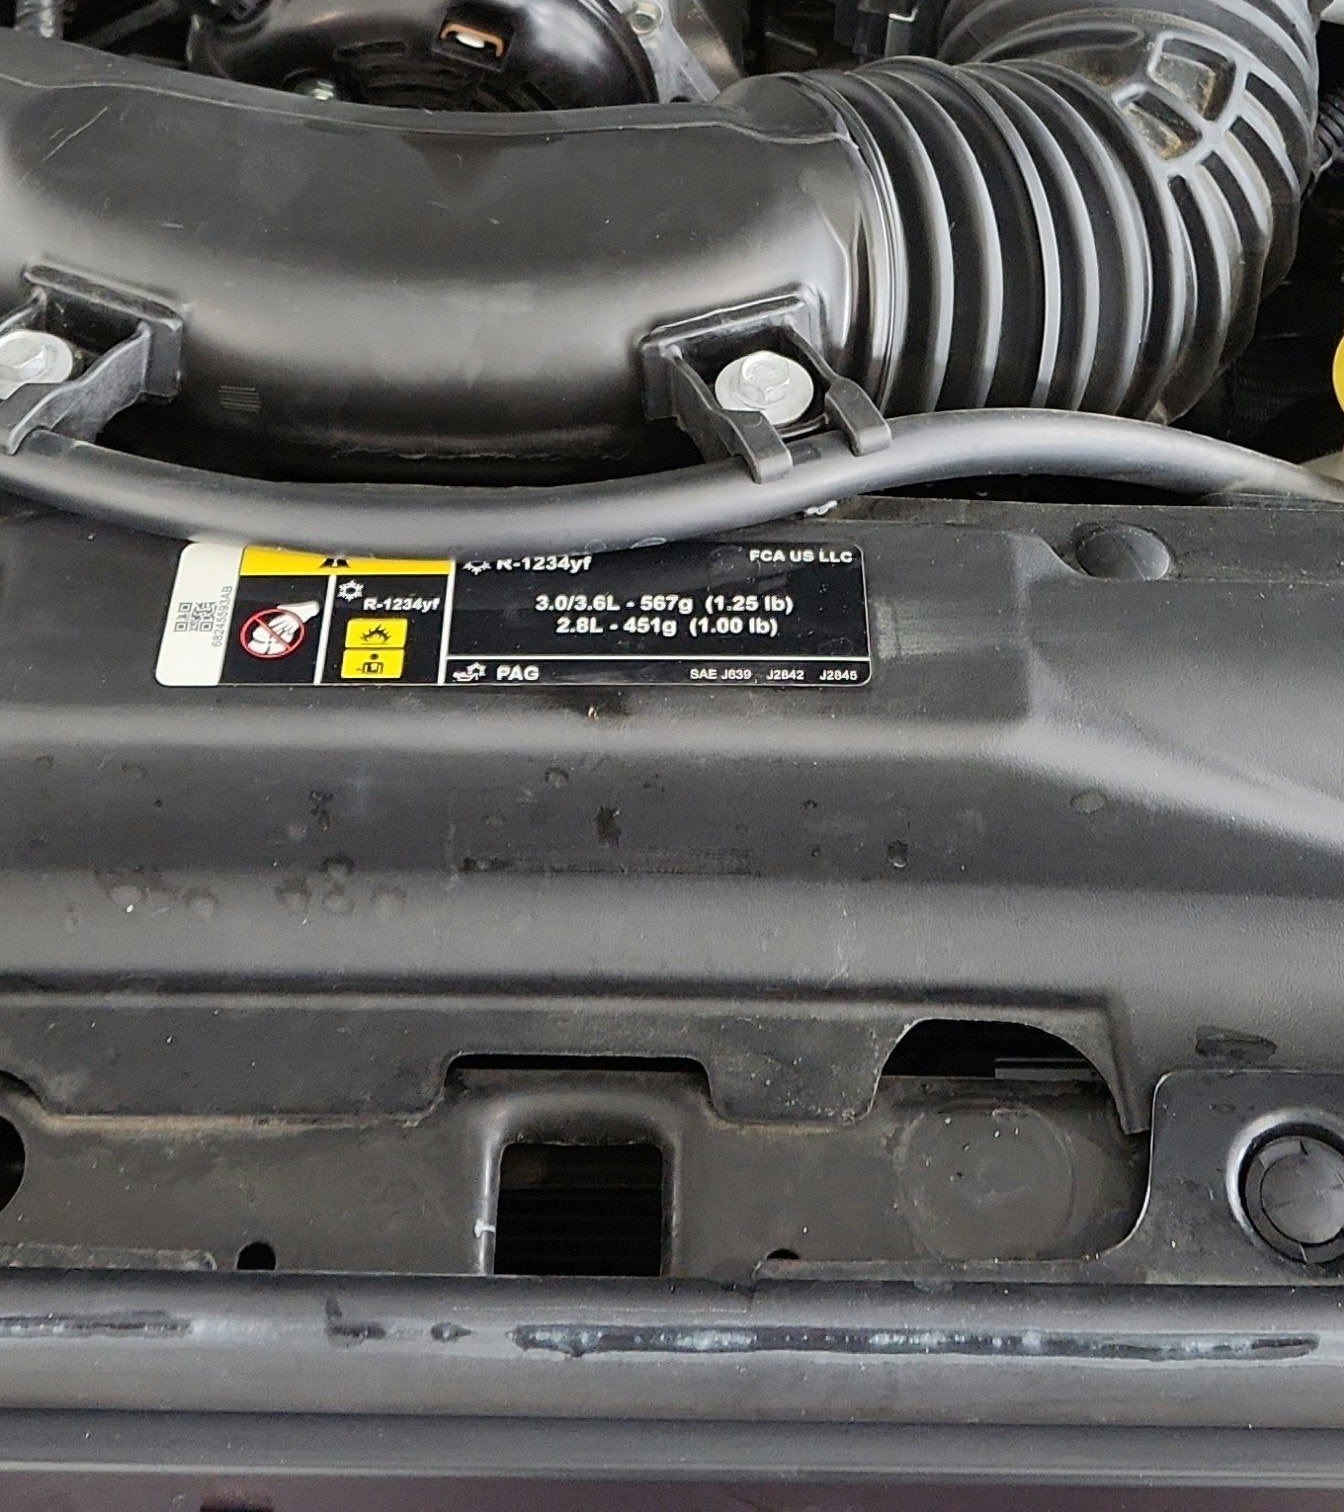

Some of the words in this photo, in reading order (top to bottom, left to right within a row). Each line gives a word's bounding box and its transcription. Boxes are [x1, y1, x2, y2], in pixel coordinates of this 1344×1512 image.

[495, 555, 593, 574] R-1234yf
[749, 549, 786, 563] FCA
[789, 550, 815, 563] US
[818, 549, 853, 564] LLC
[362, 596, 441, 613] R-1234yf
[534, 593, 621, 612] 3.0/3.6L
[640, 594, 694, 615] 567g
[705, 594, 760, 615] (1.25
[764, 594, 794, 615] lb)
[555, 616, 604, 634] 2.8L
[622, 616, 678, 637] 451g
[689, 616, 744, 637] (1.00
[748, 616, 778, 638] lb)
[495, 663, 540, 682] PAG
[689, 668, 718, 680] SAE
[720, 668, 752, 680] J639
[765, 669, 805, 681] J2842
